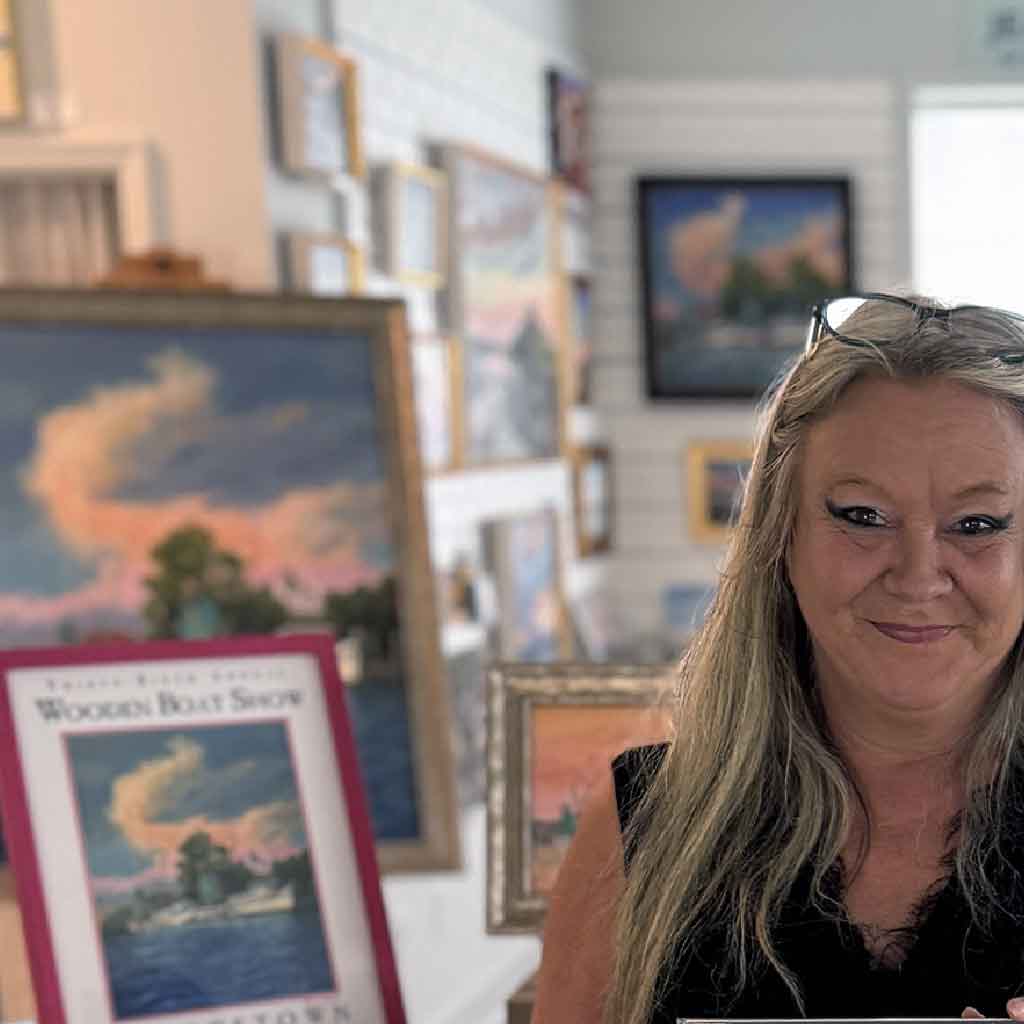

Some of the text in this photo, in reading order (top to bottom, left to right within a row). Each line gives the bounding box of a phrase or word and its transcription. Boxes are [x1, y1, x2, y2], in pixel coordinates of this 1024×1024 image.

[35, 685, 304, 721] WOODEN BOAT SHOW
